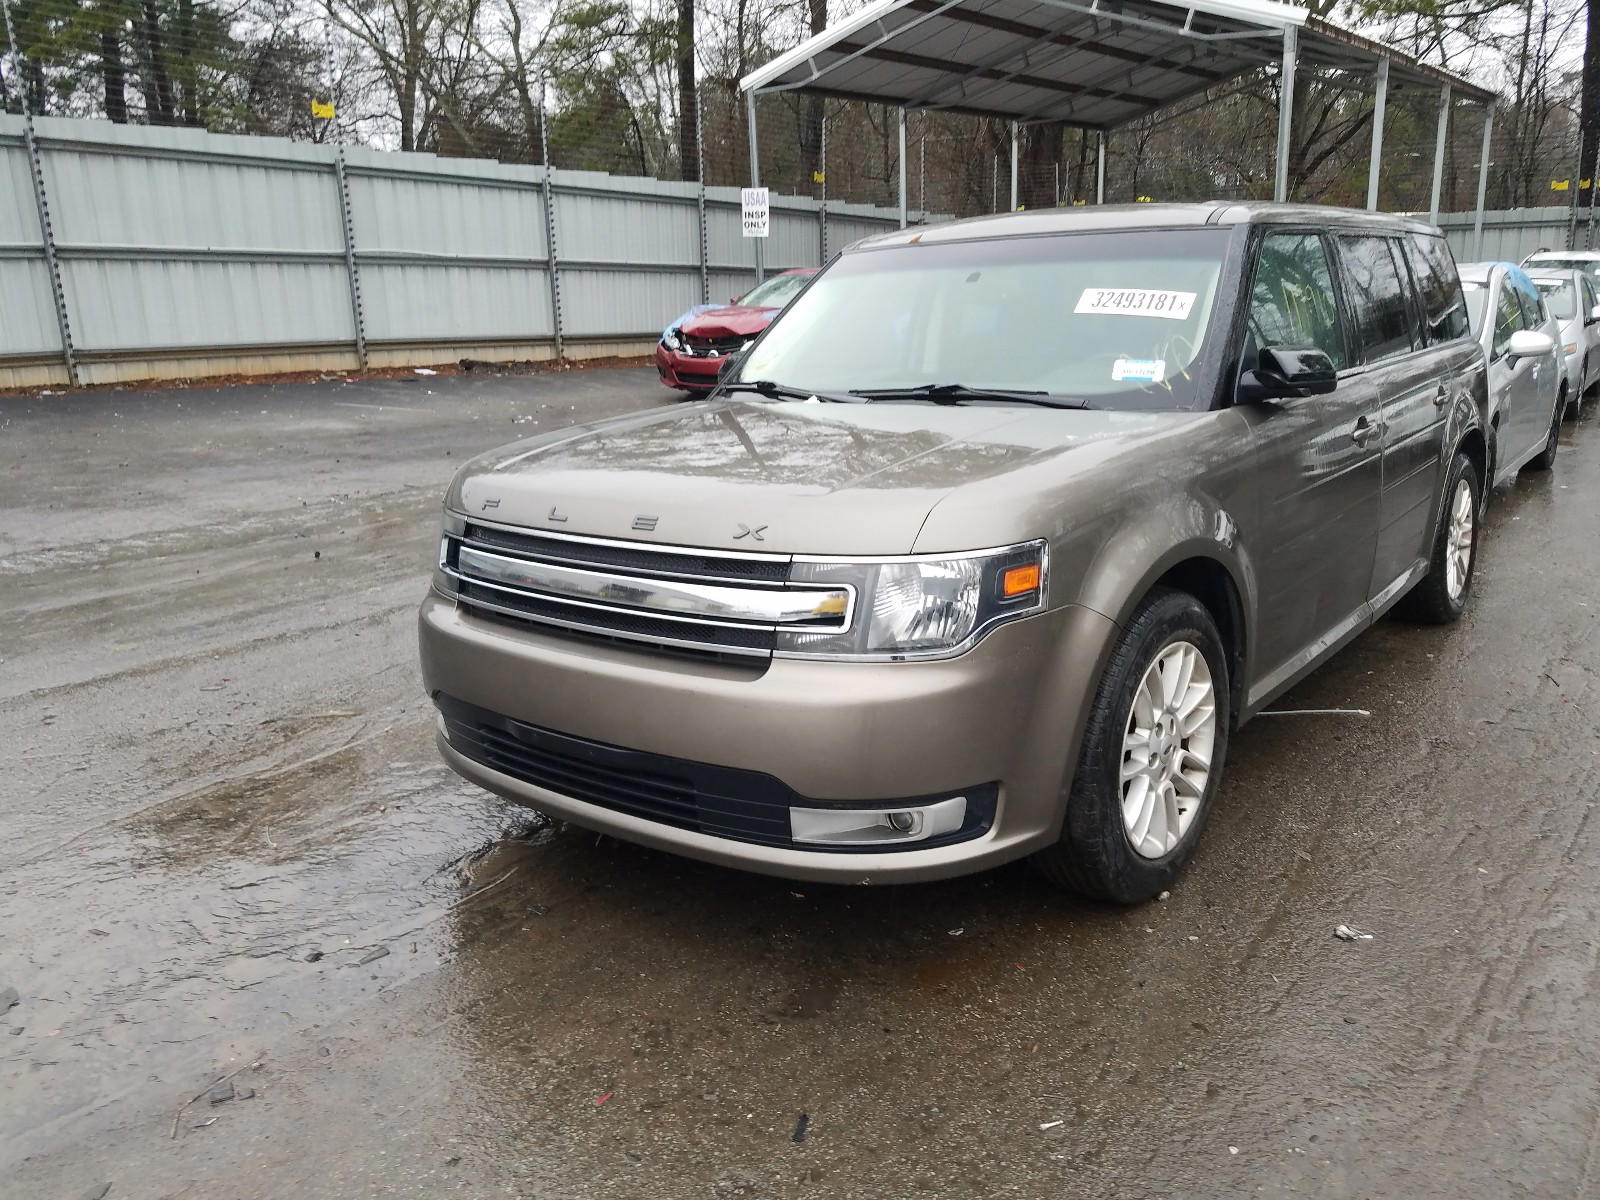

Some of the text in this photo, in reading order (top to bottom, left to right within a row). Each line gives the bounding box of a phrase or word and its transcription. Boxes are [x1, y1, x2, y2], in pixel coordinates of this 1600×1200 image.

[744, 191, 767, 206] USAA
[744, 211, 766, 219] INSP
[743, 221, 767, 229] ONLY
